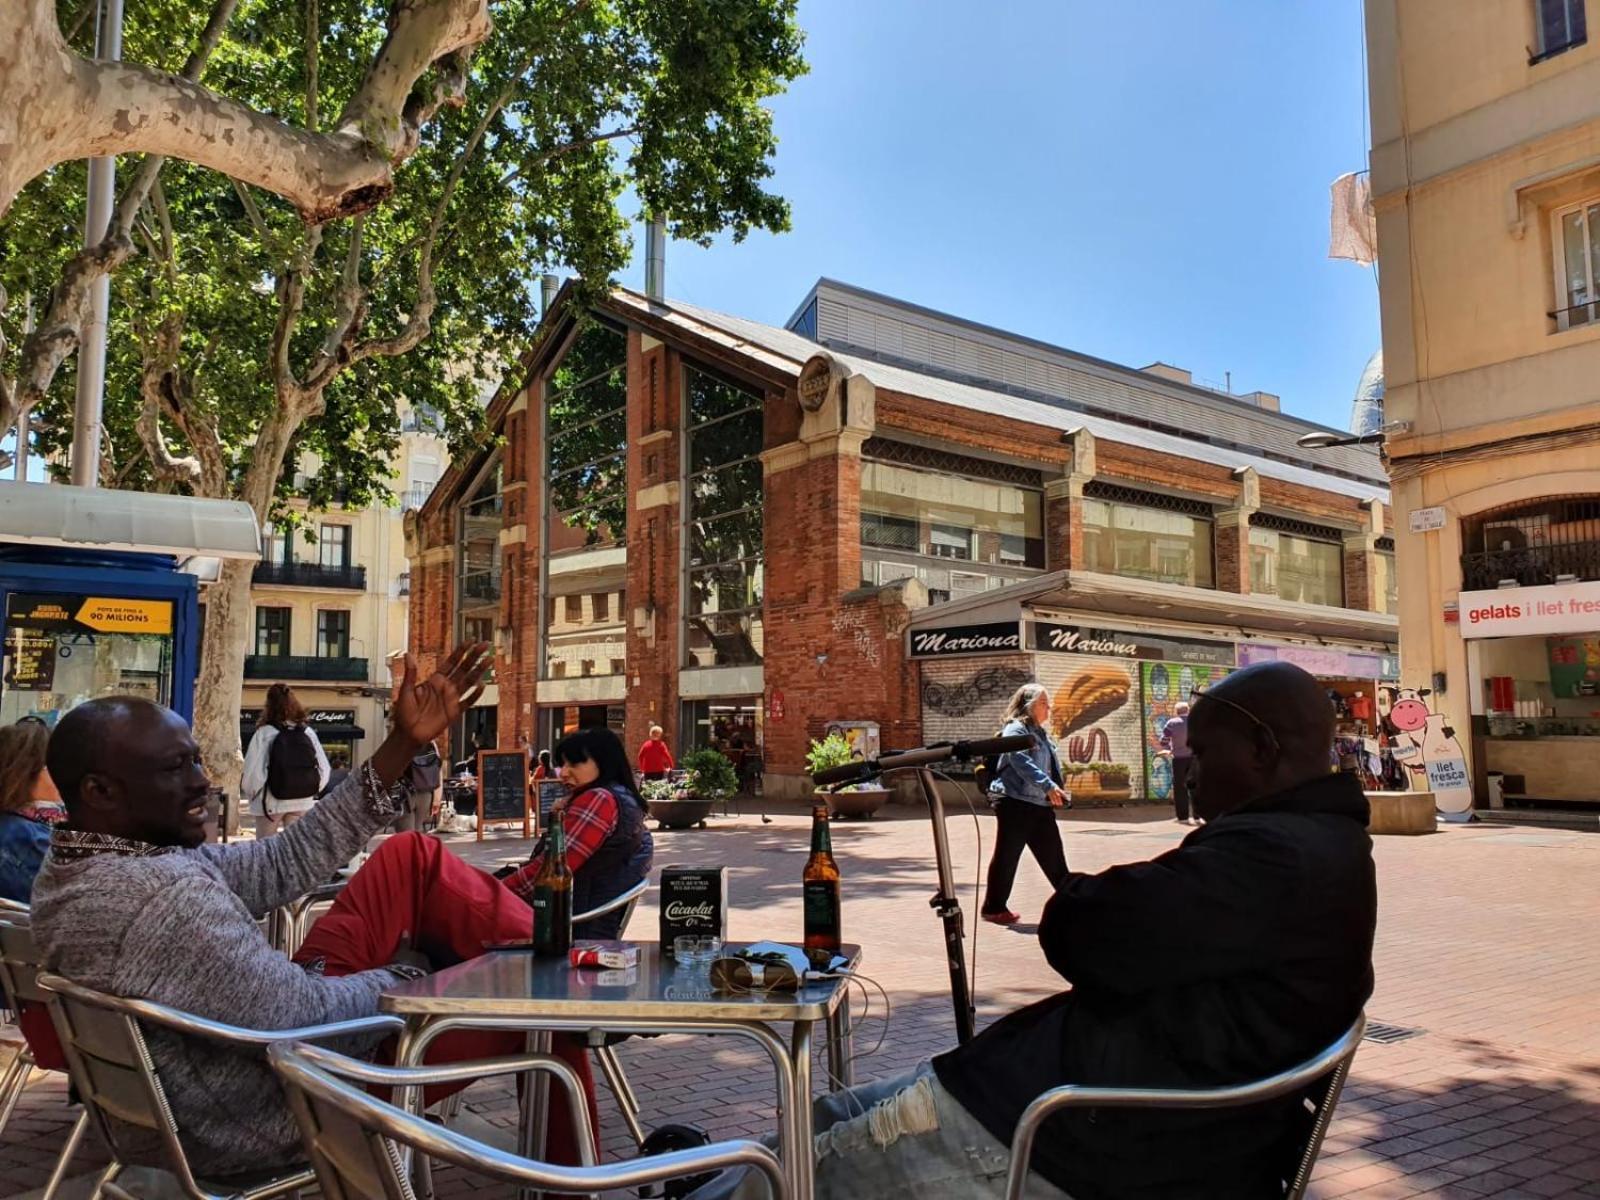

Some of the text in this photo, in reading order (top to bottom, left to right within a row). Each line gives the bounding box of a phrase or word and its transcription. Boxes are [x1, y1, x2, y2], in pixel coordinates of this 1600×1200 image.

[89, 613, 103, 621] 90
[105, 613, 150, 623] MILIONS
[1469, 605, 1521, 623] gelats
[1527, 603, 1531, 616] i
[1537, 600, 1564, 615] llet
[914, 633, 1019, 651] Mariona
[1049, 628, 1137, 656] Mariona
[1436, 762, 1455, 772] llet
[1431, 771, 1465, 783] fresca
[665, 900, 715, 920] Cacaolat
